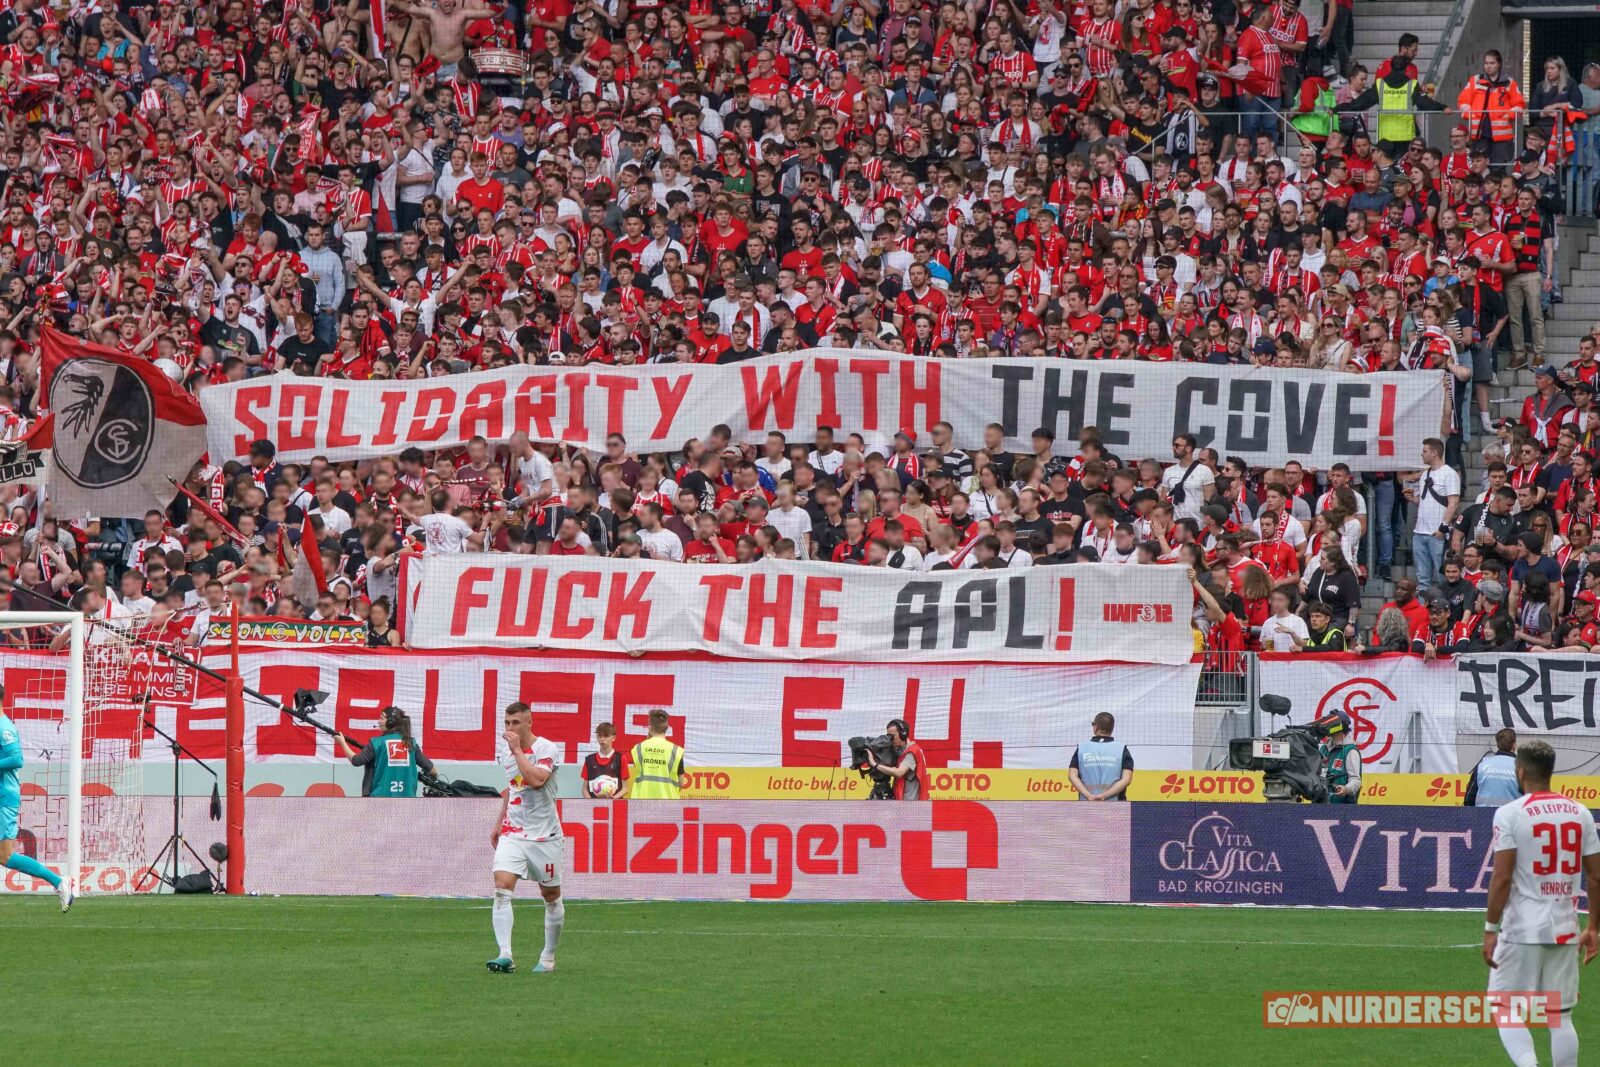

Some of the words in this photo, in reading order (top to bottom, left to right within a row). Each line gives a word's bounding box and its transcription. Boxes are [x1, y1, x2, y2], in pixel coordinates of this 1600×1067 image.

[232, 371, 694, 456] SOLIDARITY
[739, 358, 942, 432] WITH
[991, 364, 1137, 446] THE
[1174, 377, 1396, 457] COVE!
[448, 566, 656, 641] FUCK
[700, 572, 843, 650] THE
[892, 577, 1075, 652] APL!
[294, 624, 362, 644] VOLTS
[390, 781, 404, 792] 25
[681, 771, 731, 790] OTTO
[767, 776, 857, 791] lotto-bw.de
[1189, 776, 1255, 794] LOTTO
[1526, 806, 1541, 817] RB
[1543, 803, 1579, 816] LEIPZIG
[1211, 825, 1253, 848] VITA
[1532, 821, 1583, 876] 39
[545, 863, 554, 878] 4
[1158, 881, 1187, 893] BAD
[1195, 881, 1283, 894] KROZINGEN
[1541, 881, 1574, 896] HENRICHS
